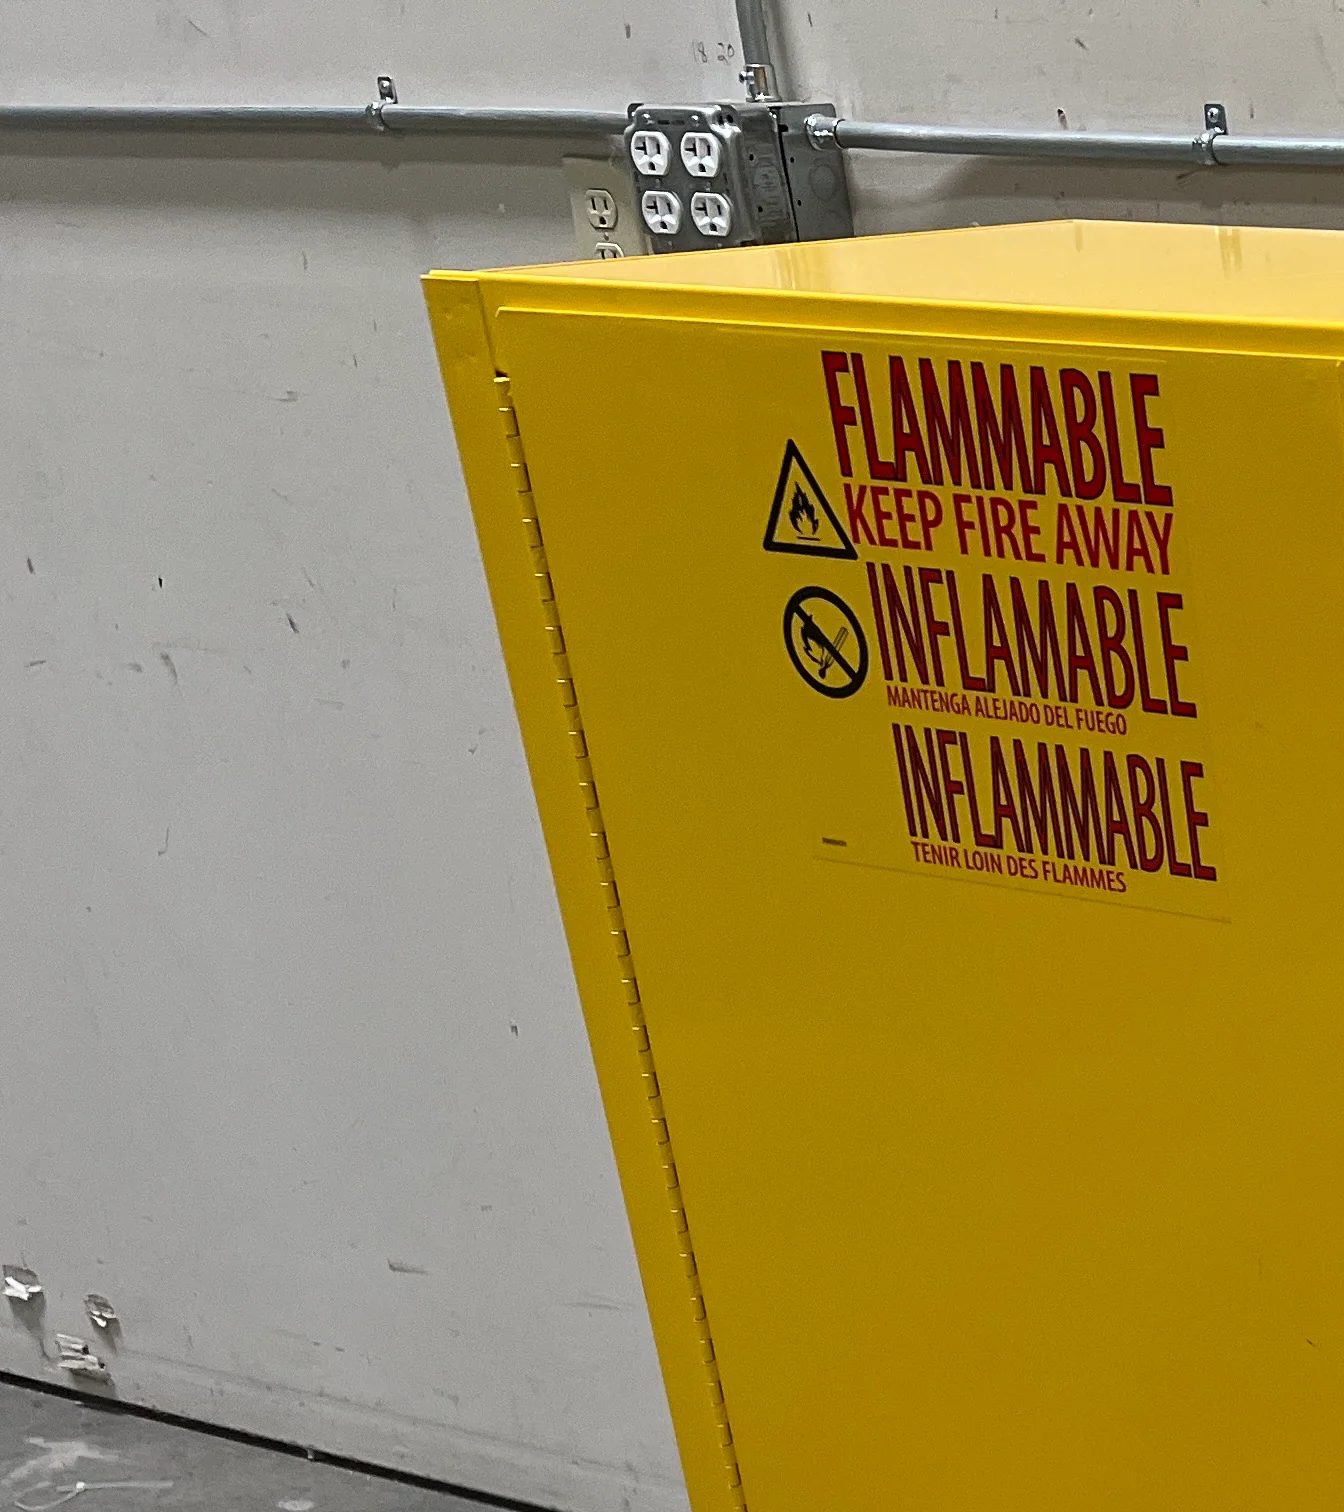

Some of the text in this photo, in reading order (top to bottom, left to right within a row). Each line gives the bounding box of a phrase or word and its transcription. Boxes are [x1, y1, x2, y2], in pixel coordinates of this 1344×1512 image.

[821, 350, 1173, 507] FLAMMABLE
[843, 483, 1173, 576] KEEP FIRE AWAY
[867, 562, 1198, 719] INFLAMABLE
[886, 684, 1128, 735] MANTENGA ALEJADO DEL FUEGO
[892, 723, 1217, 881] INFLAMMABLE
[911, 841, 1127, 893] TENIR LOIN DES FLAMMES
